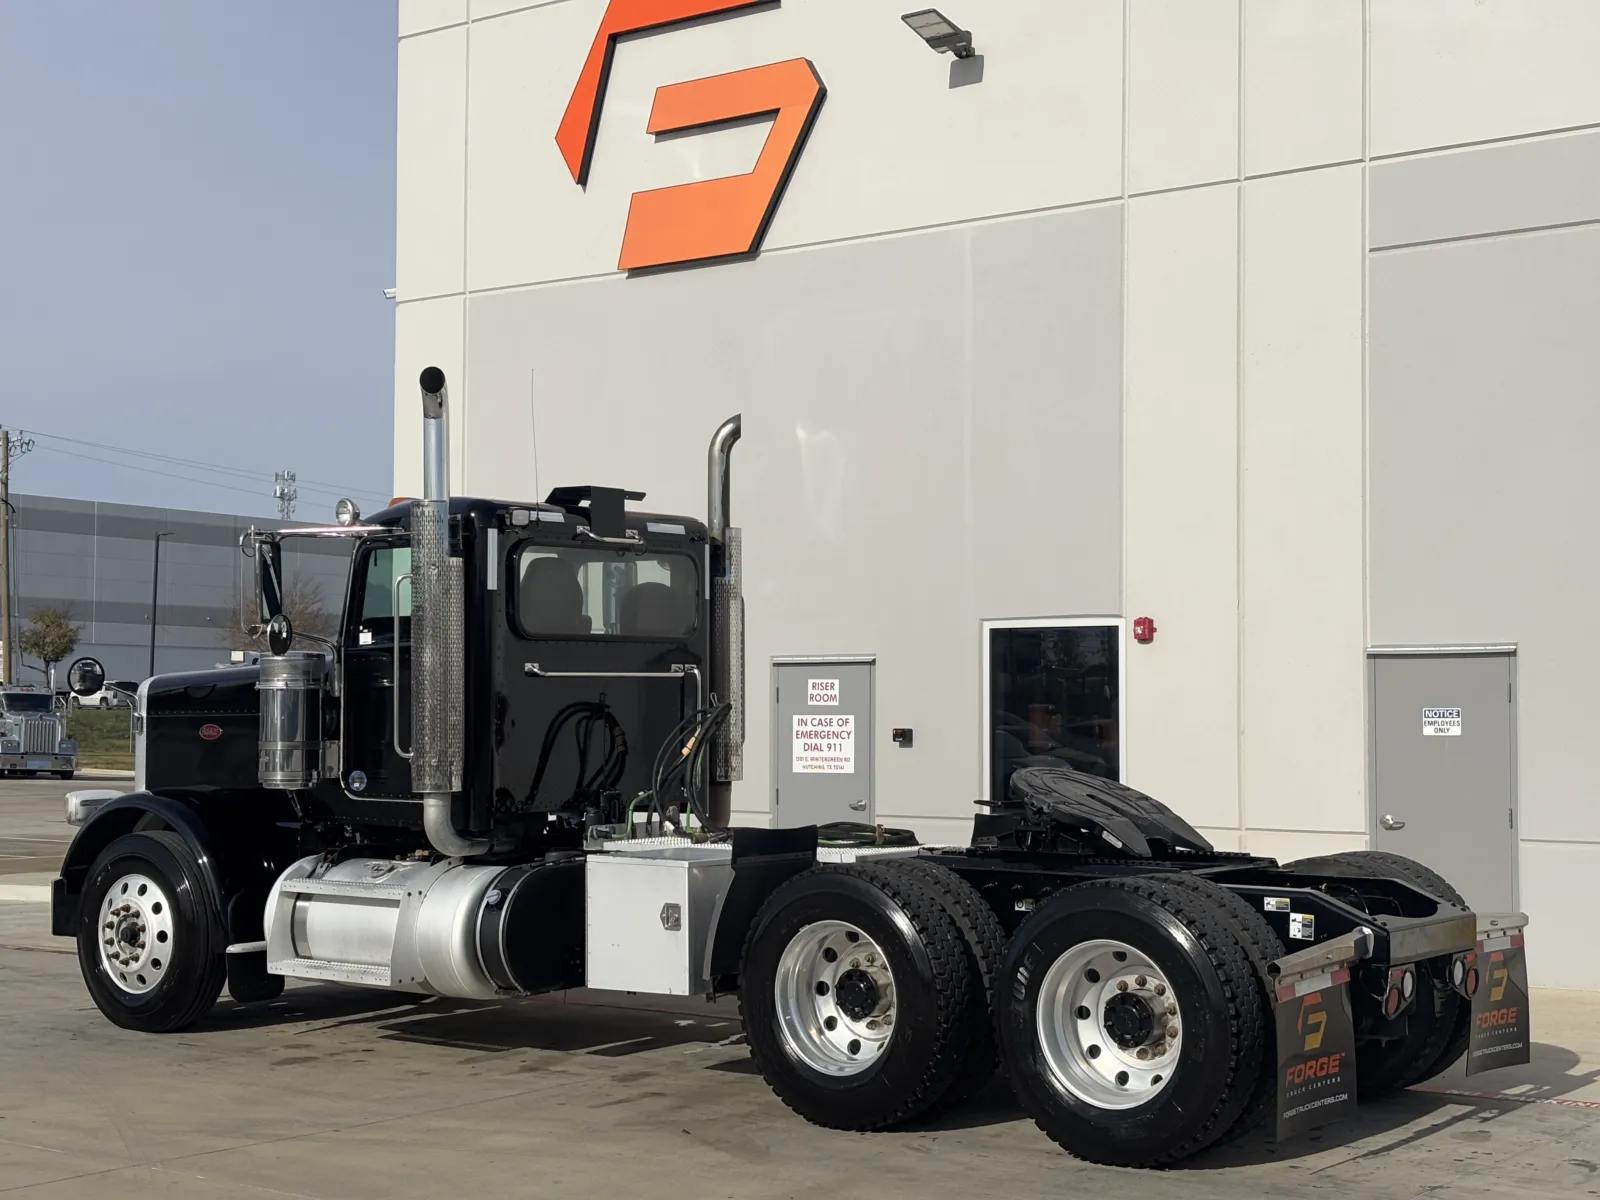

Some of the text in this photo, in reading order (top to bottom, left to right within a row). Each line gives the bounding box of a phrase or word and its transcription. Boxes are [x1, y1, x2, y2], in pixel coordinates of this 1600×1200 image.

[811, 682, 835, 691] RISER
[809, 693, 838, 702] ROOM
[1425, 710, 1459, 718] NOTICE
[797, 718, 850, 727] IN CASE OF
[795, 730, 852, 740] EMERGENCY
[803, 743, 842, 752] DIAL 911
[1476, 1007, 1518, 1029] FORGE
[1285, 1053, 1341, 1089] FORGE
[1286, 1076, 1341, 1098] TRUCK CENTERS
[1283, 1093, 1348, 1119] FORGETRUCKCENTERS.COM
